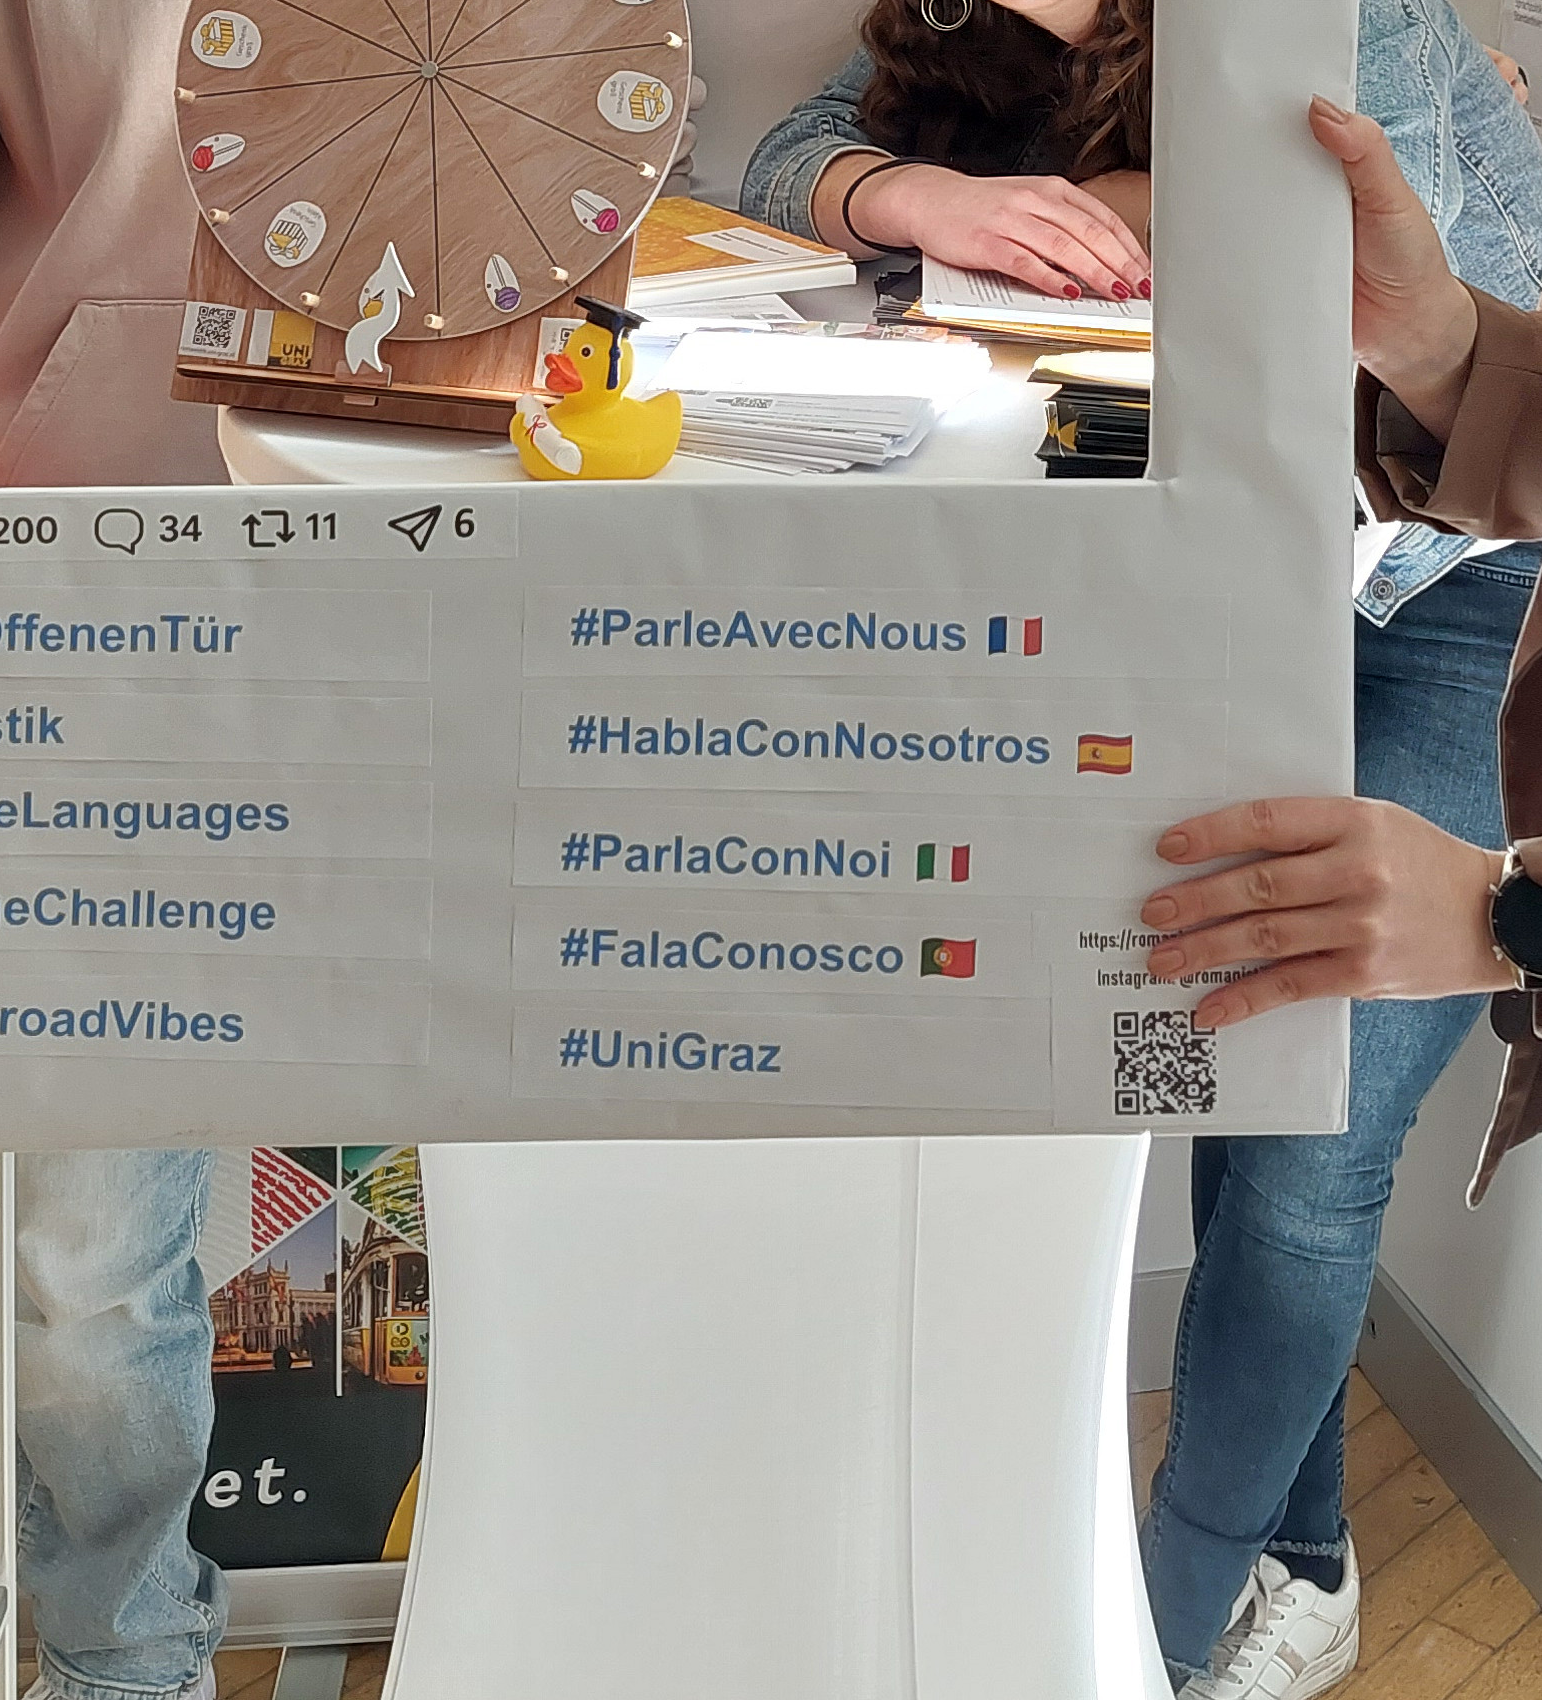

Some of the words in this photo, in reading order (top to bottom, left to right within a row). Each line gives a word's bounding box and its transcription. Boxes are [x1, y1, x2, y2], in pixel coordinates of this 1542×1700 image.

[282, 344, 309, 356] UNI
[158, 515, 203, 543] 34
[305, 512, 338, 541] 11
[455, 509, 475, 539] 6
[570, 608, 967, 652] #ParleAvecNous
[567, 715, 1051, 765] #HablaConNosotros
[560, 832, 891, 880] #ParlaConNoi
[560, 928, 904, 974] #FalaConosco
[560, 1028, 781, 1074] #UniGraz
